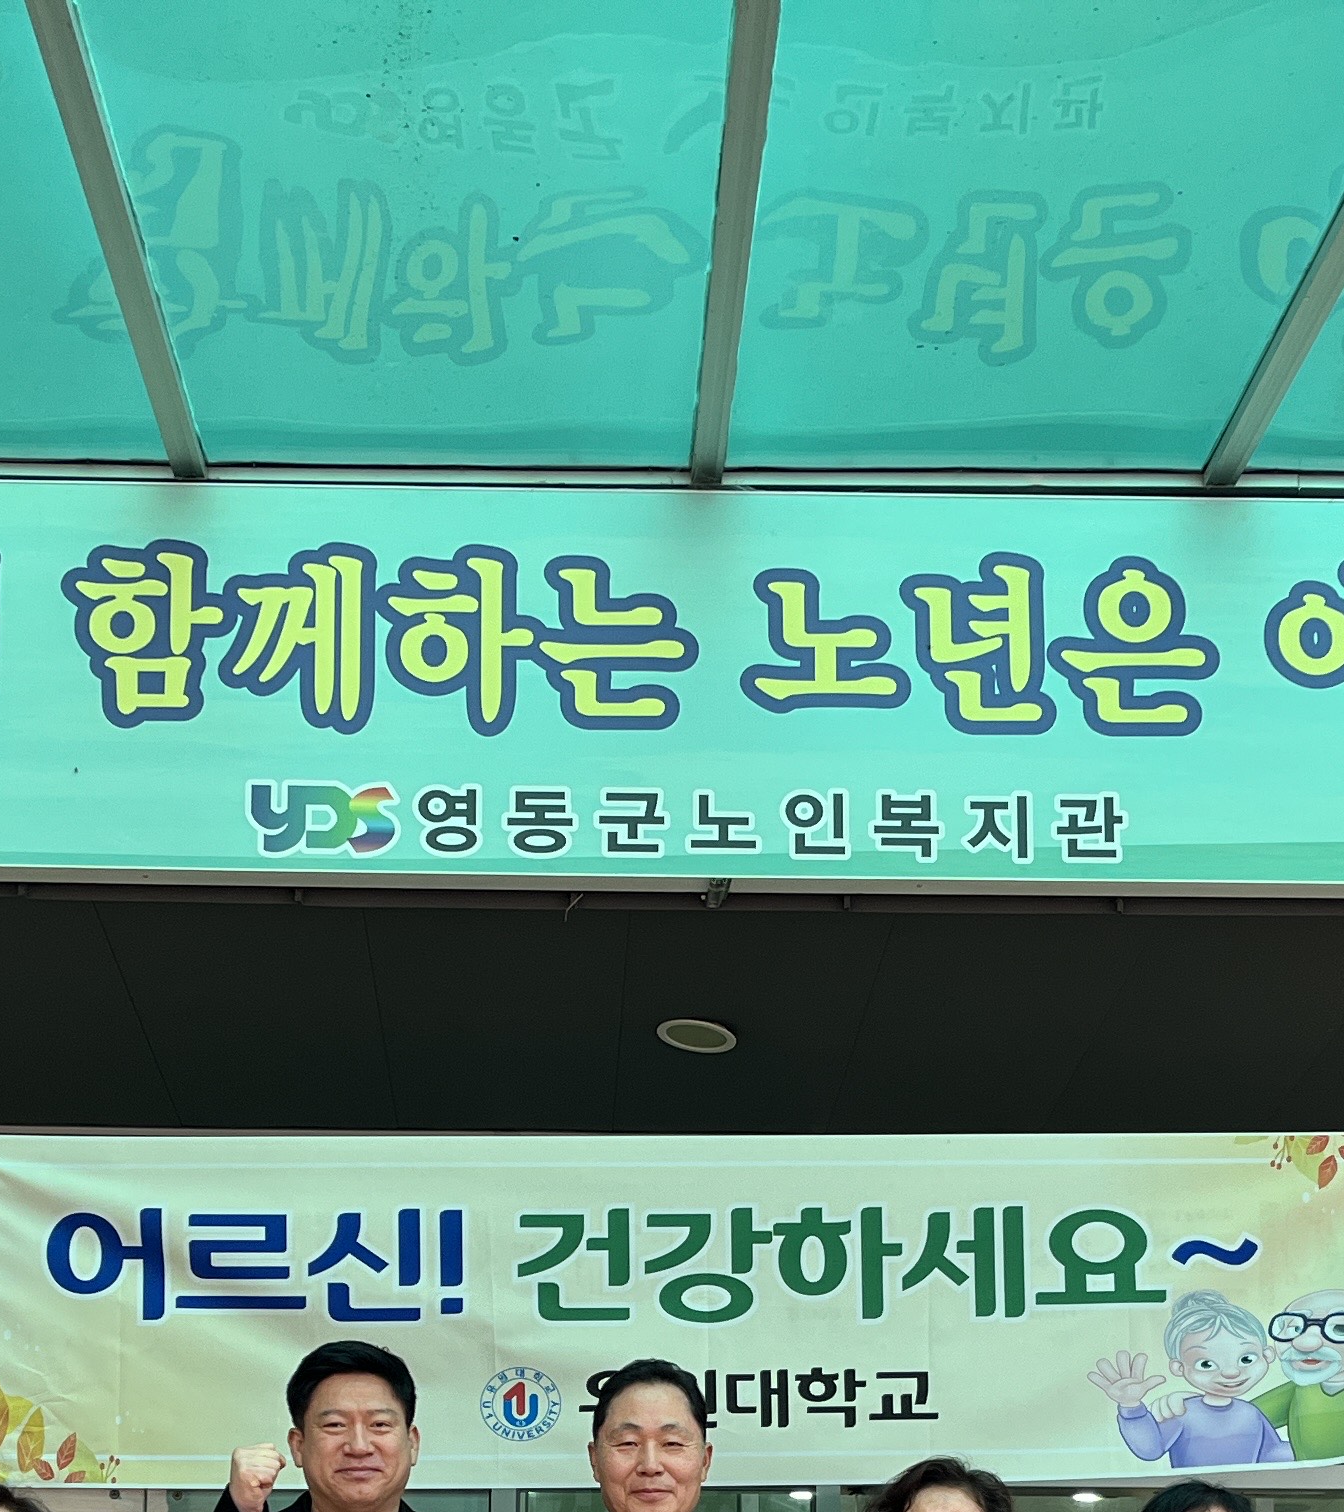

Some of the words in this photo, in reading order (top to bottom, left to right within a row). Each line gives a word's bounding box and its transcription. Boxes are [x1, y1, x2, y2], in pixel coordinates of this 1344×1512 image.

[61, 539, 699, 737] 함께하는
[740, 551, 1220, 737] 노년은
[249, 784, 396, 856] YDS
[418, 787, 1123, 862] 영동군노인복지관
[45, 1206, 464, 1323] 어르신!
[516, 1205, 1259, 1323] 건강하세요~
[579, 1366, 939, 1429] 대학교
